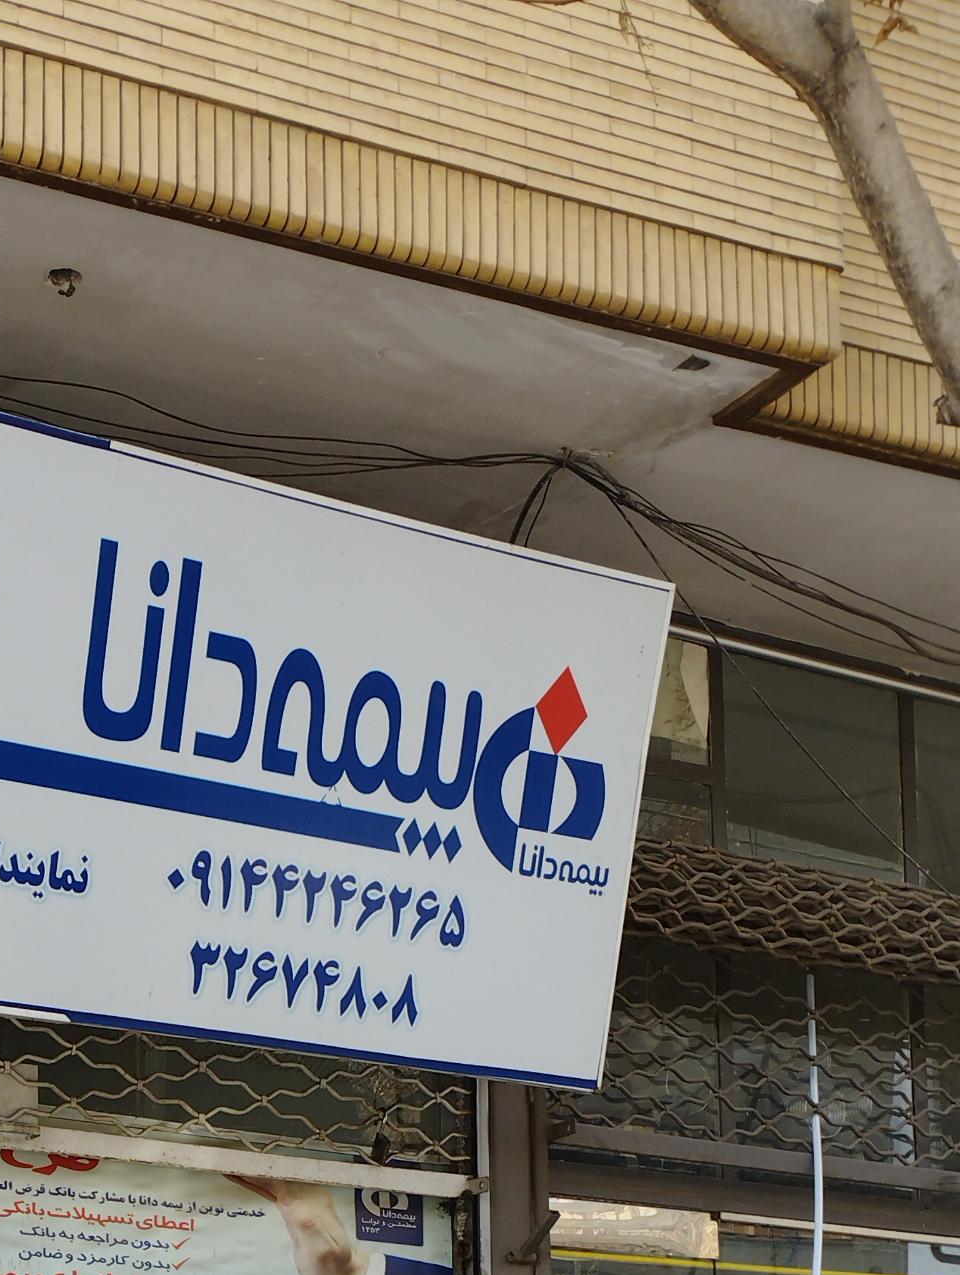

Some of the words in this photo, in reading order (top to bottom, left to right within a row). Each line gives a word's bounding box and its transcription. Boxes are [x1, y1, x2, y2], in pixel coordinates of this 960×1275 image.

[82, 537, 258, 764] دانا
[261, 647, 484, 864] بیمه
[519, 842, 558, 879] دانا
[557, 857, 610, 896] بیمه
[166, 849, 467, 949] ۰۹۱۴۴۲۴۶۲۶۵
[189, 939, 420, 1028] ۳۲۶۷۴۸۰۸
[14, 1183, 47, 1197] قرض
[47, 1185, 77, 1200] بانک
[77, 1190, 126, 1204] مشارکت
[128, 1194, 137, 1207] با
[139, 1195, 159, 1208] دانا
[160, 1201, 184, 1212] بیمه
[186, 1202, 197, 1213] از
[46, 1205, 134, 1228] تسهیلات
[199, 1205, 225, 1216] نوین
[135, 1214, 196, 1232] اعطای
[18, 1226, 57, 1242] بانک
[58, 1231, 75, 1245] به
[76, 1232, 129, 1247] مراجعه
[131, 1236, 171, 1253] بدون
[17, 1247, 64, 1262] ضامن
[65, 1254, 75, 1265] و
[76, 1253, 130, 1268] کارمزد
[131, 1257, 172, 1273] بدون
